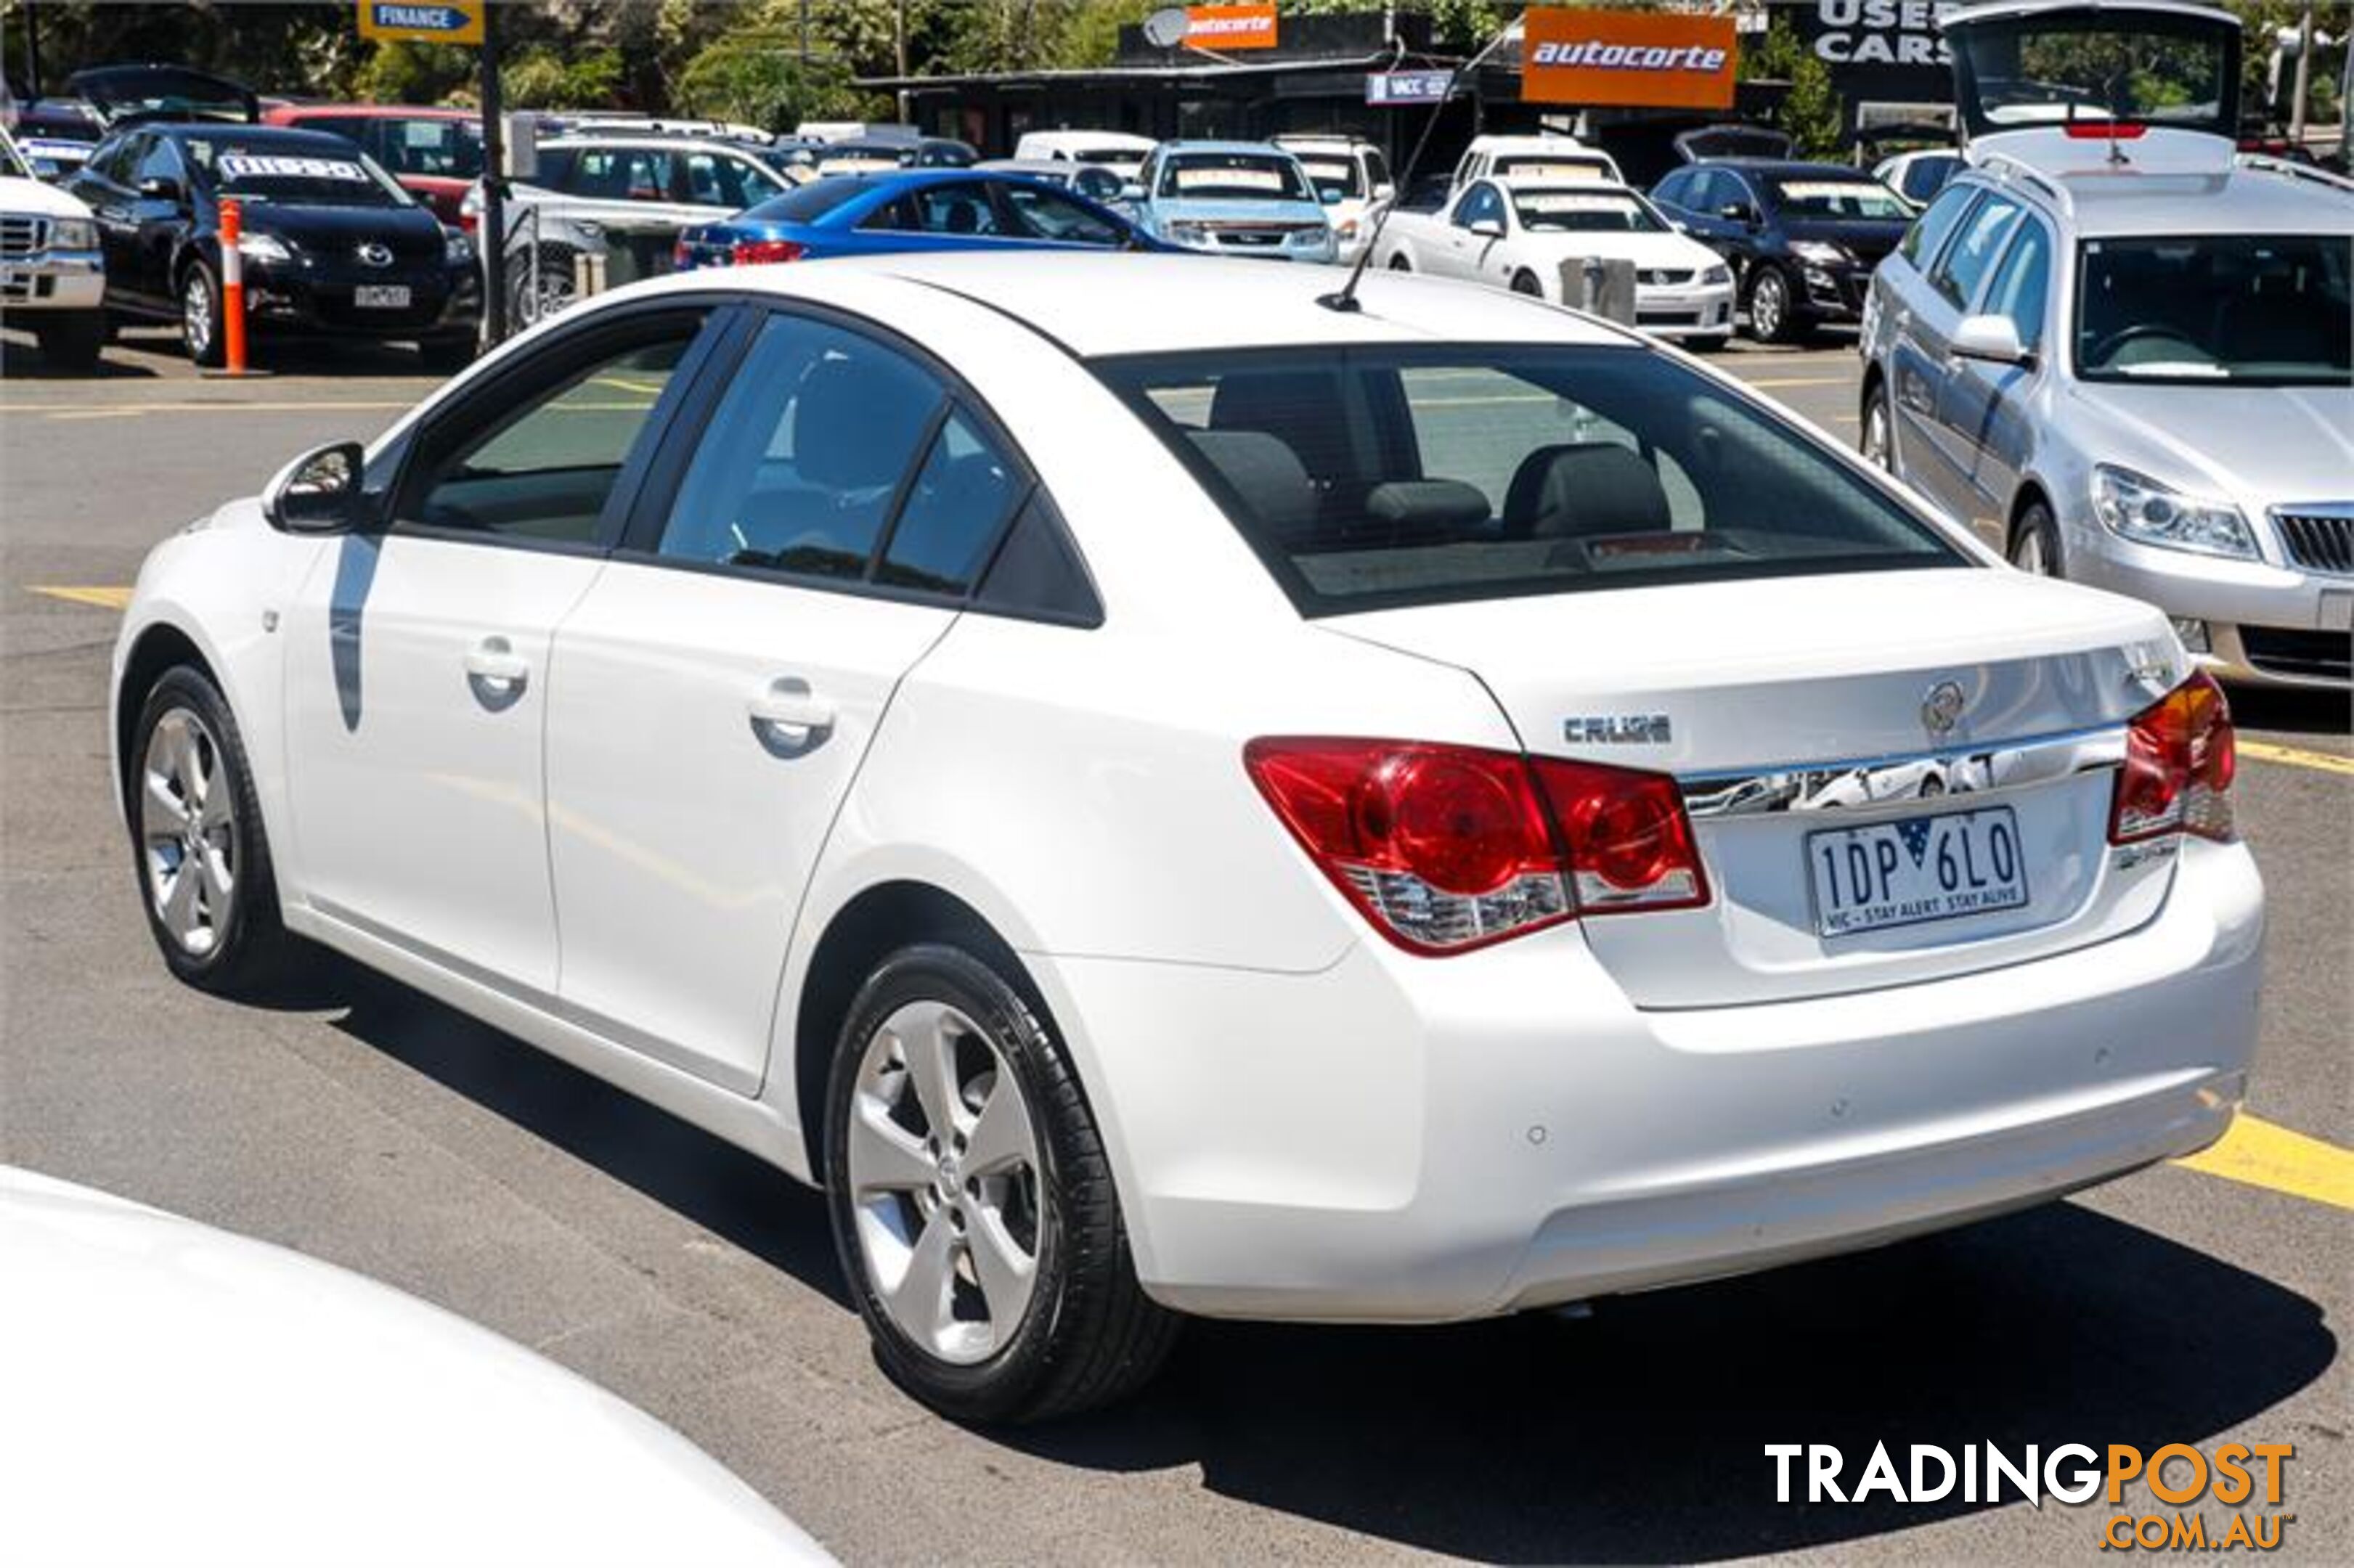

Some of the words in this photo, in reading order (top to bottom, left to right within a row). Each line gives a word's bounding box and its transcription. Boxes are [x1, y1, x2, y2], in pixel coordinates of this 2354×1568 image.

[378, 6, 449, 28] FINANCE
[1532, 41, 1725, 69] autocorte
[1822, 838, 1898, 909] 1DP
[1864, 907, 1895, 924] STAY
[1900, 899, 1940, 917] ALERT
[1947, 894, 1979, 910] STAY
[1983, 886, 2017, 905] ALIVE
